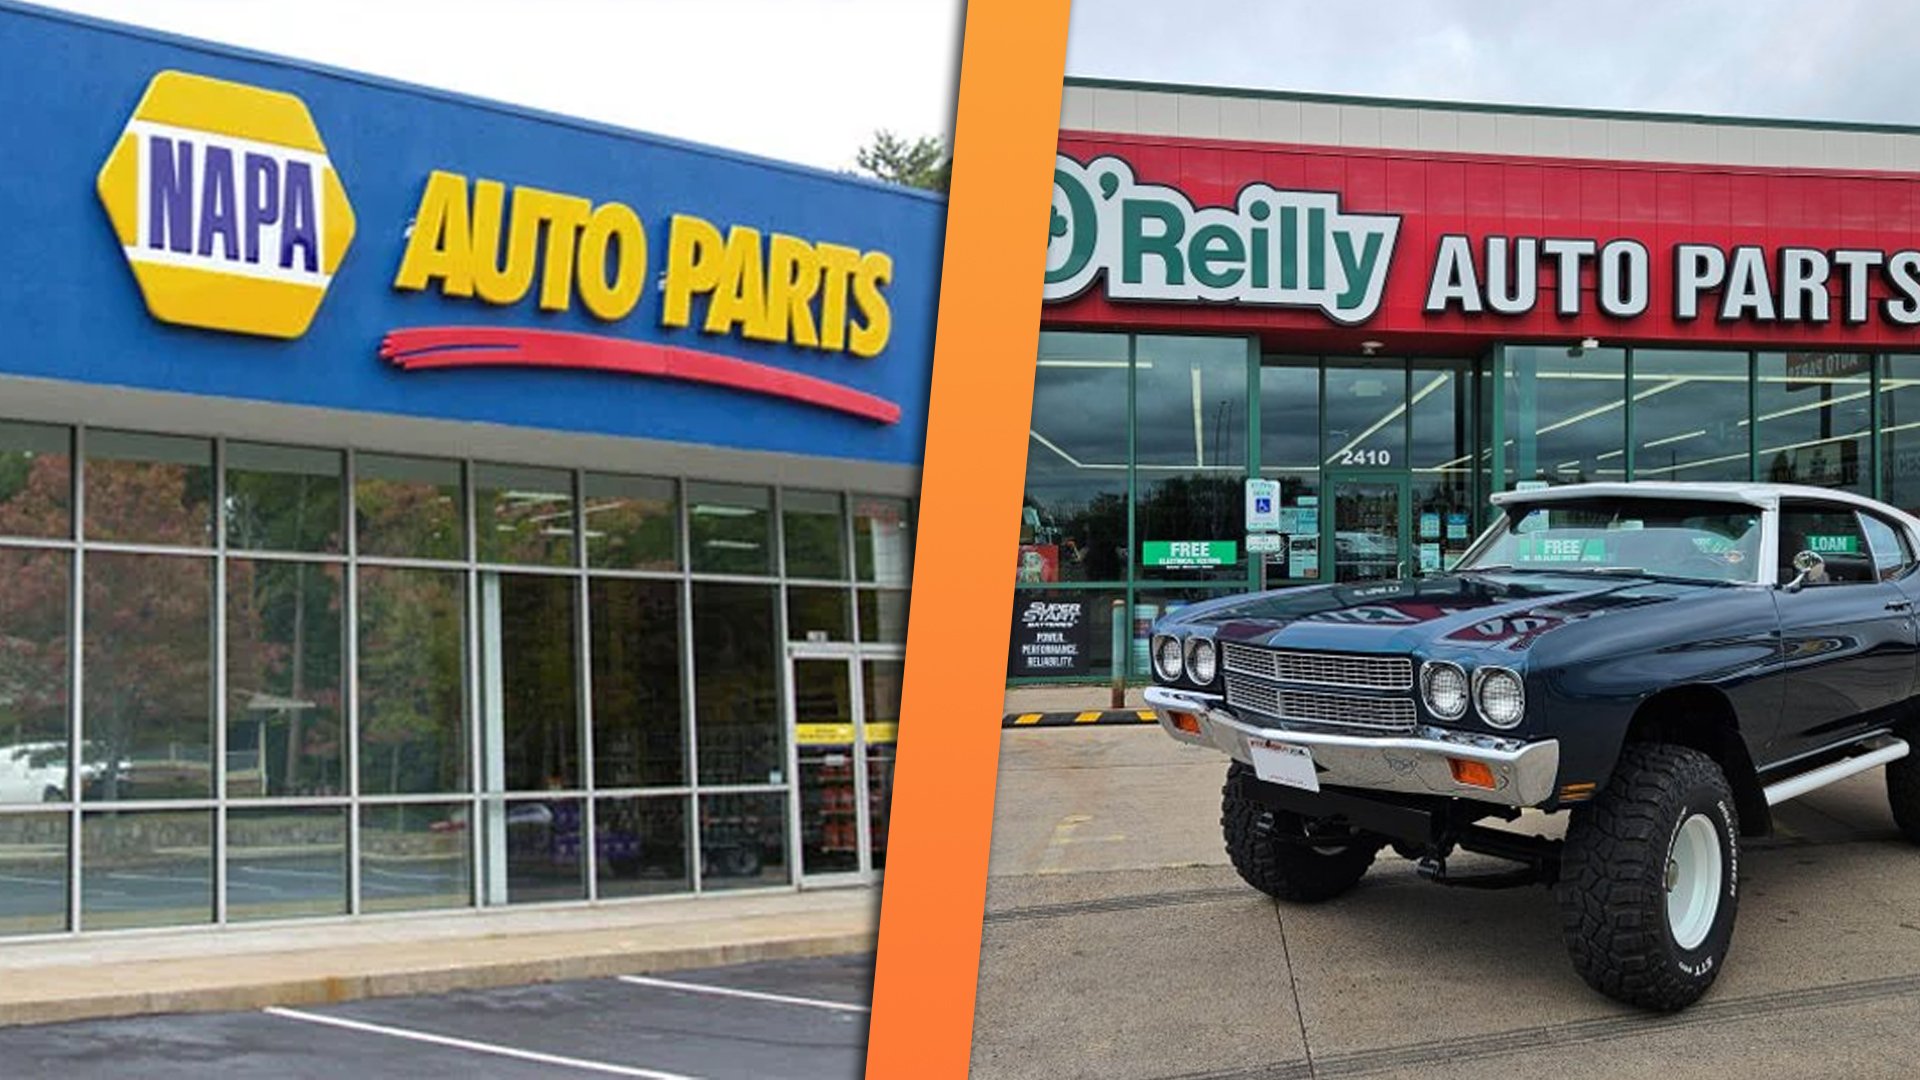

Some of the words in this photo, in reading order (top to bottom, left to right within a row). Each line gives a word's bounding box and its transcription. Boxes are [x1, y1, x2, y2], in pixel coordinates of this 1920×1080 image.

[149, 135, 319, 273] NAPA
[395, 170, 647, 321] AUTO
[663, 214, 893, 358] PARTS
[1426, 236, 1649, 316] AUTO
[1678, 245, 1920, 324] PARTS
[1341, 450, 1391, 465] 2410
[1170, 542, 1210, 557] FREE
[1544, 540, 1580, 554] FREE
[1811, 536, 1847, 551] LOAN
[1030, 602, 1081, 615] SUPER
